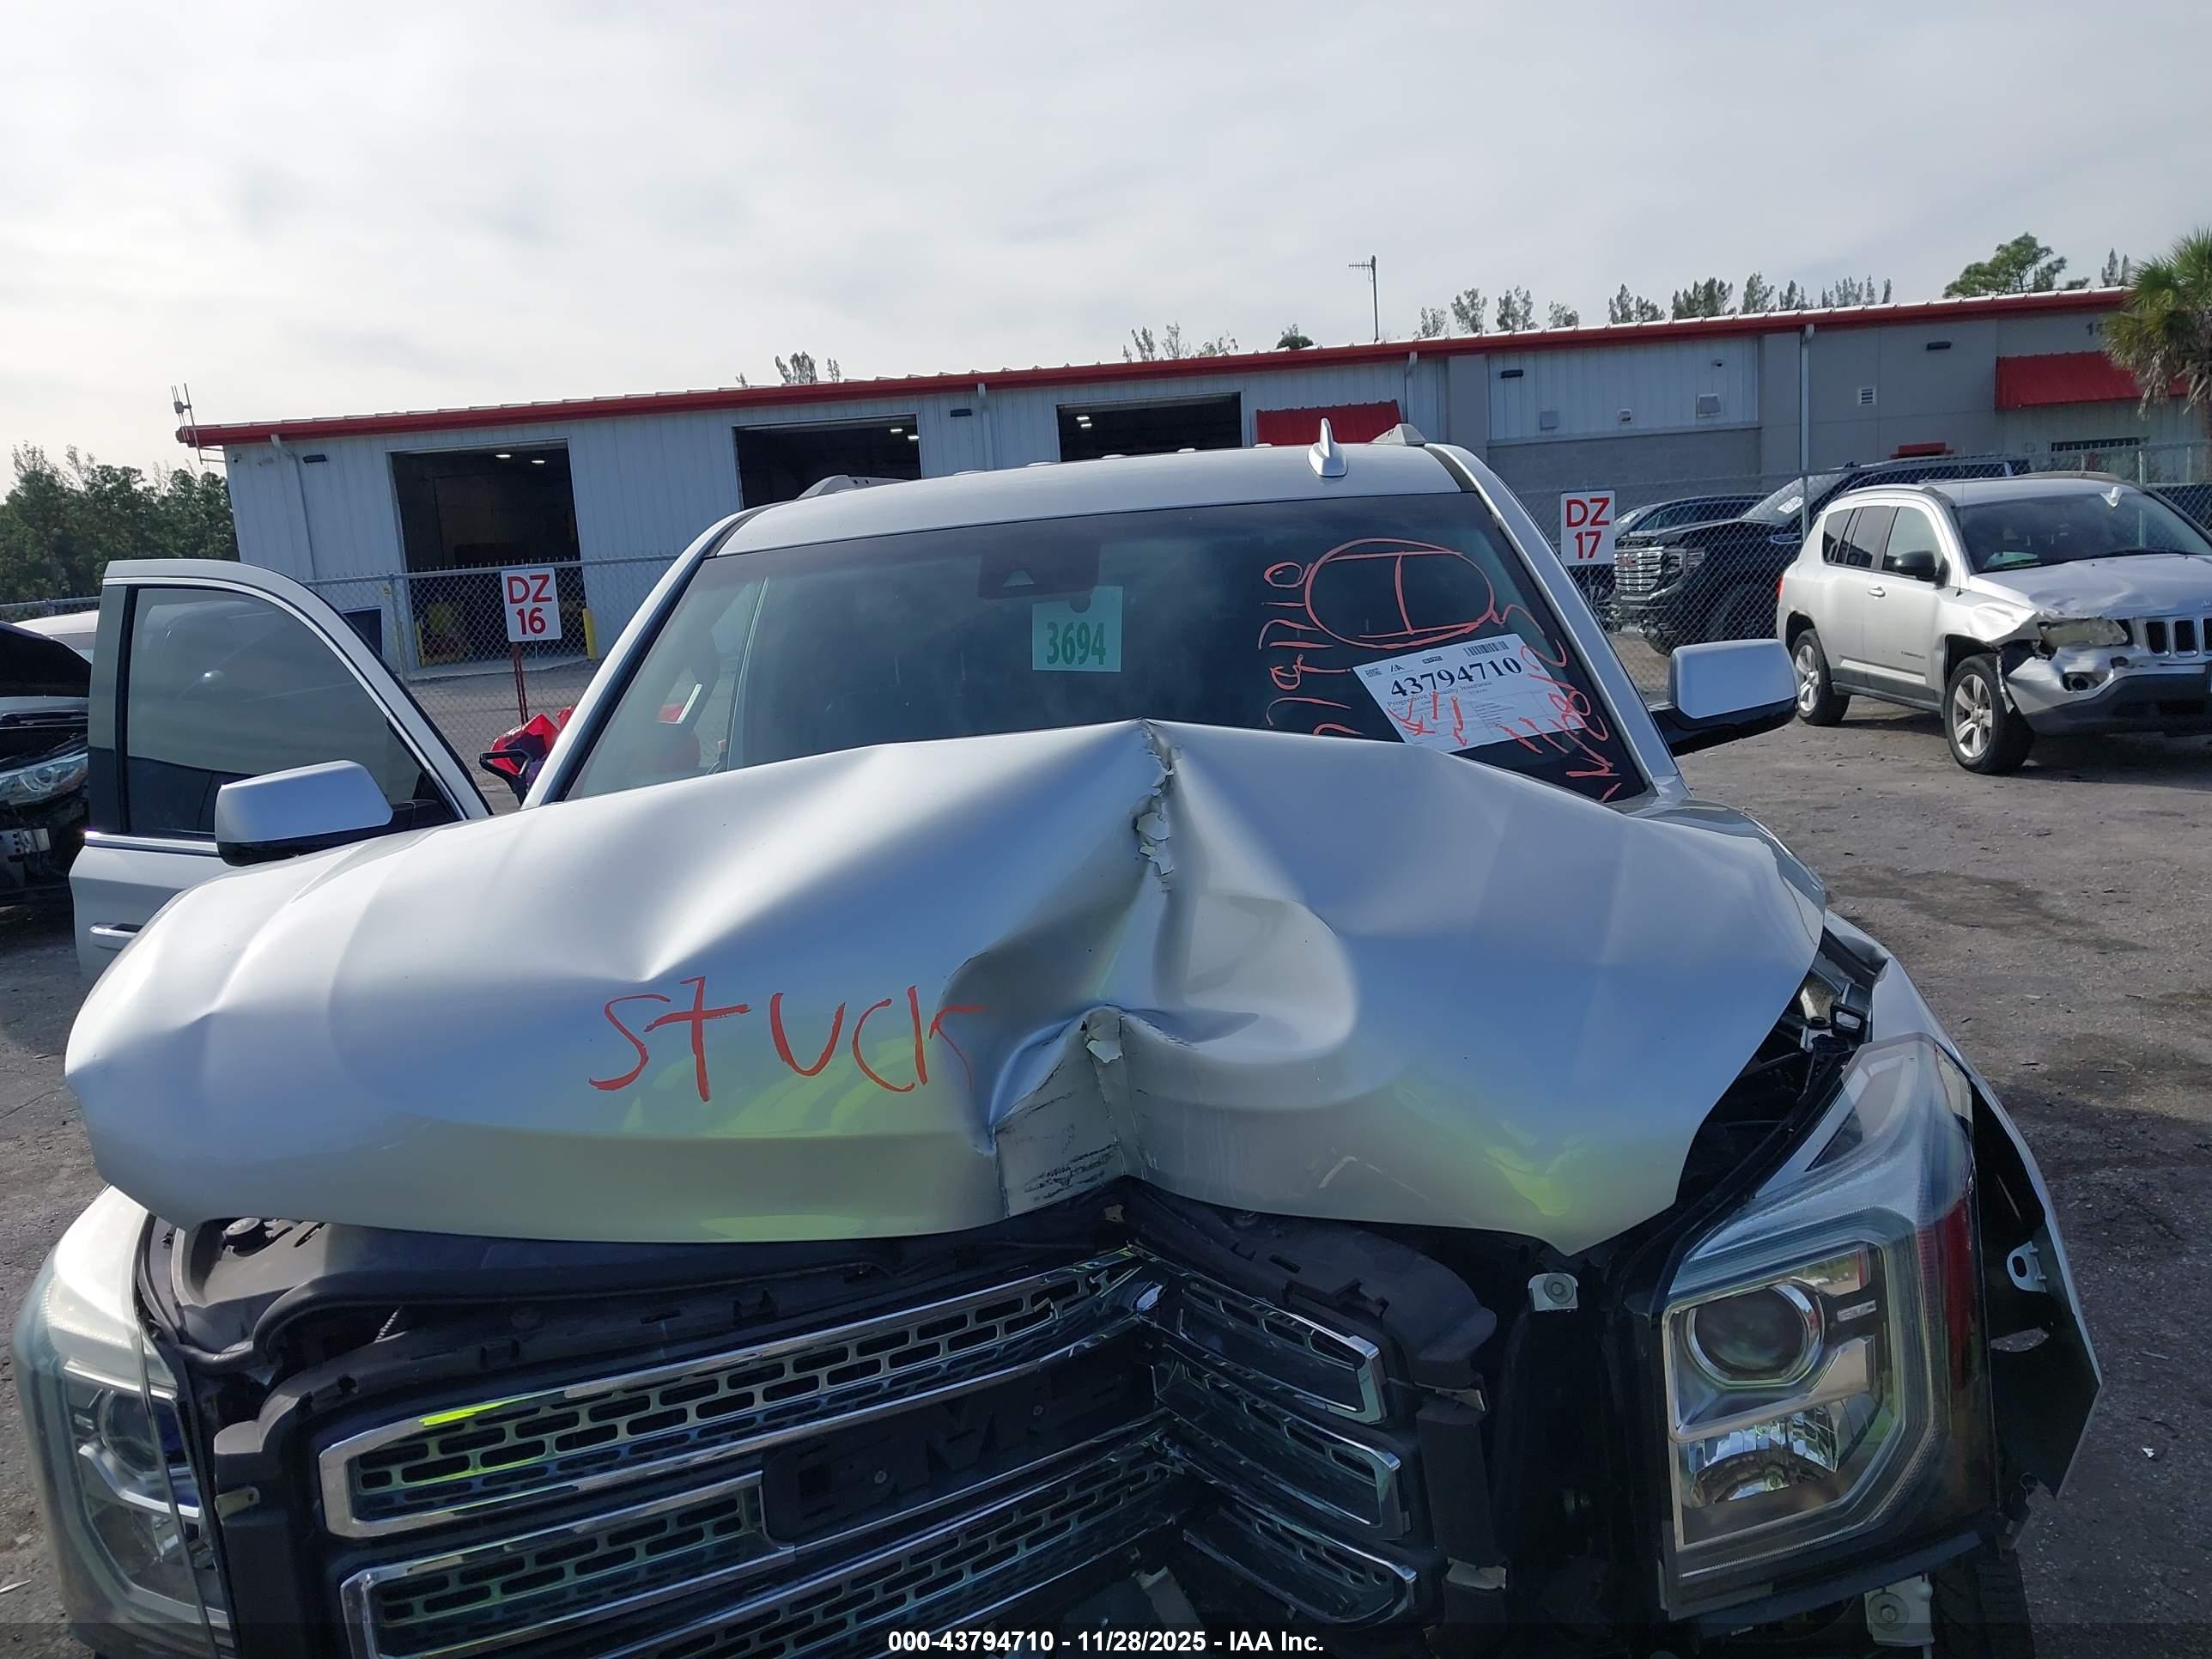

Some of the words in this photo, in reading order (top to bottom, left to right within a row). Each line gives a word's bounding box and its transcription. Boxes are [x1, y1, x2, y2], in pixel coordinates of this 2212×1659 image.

[1566, 497, 1610, 527] DZ
[1574, 531, 1601, 559] 17
[507, 574, 552, 604] DZ
[516, 606, 545, 635] 16
[1046, 621, 1106, 665] 3694
[1390, 657, 1522, 696] 43794710
